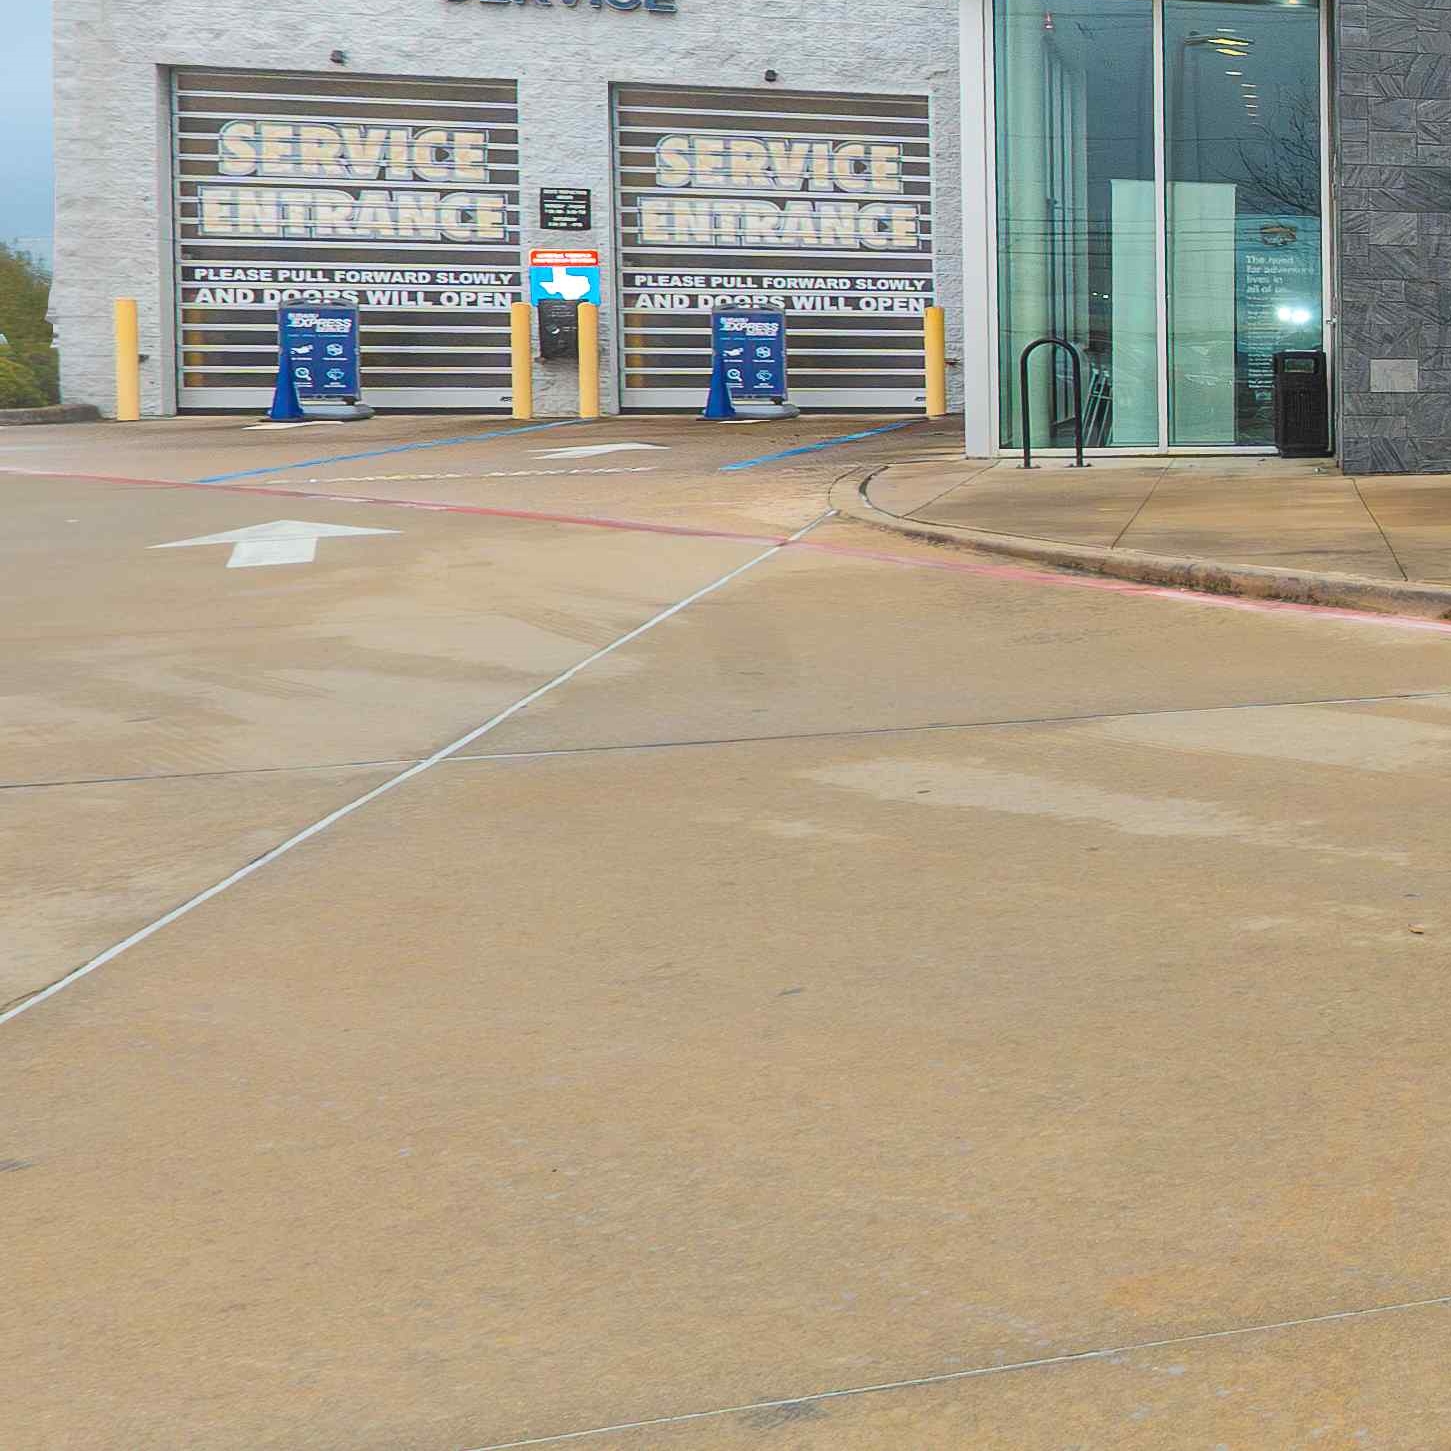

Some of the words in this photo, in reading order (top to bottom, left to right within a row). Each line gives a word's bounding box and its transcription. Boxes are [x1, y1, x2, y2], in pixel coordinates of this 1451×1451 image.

[219, 120, 489, 182] SERVICE
[656, 134, 903, 194] SERVICE
[198, 185, 509, 242] ENTRANCE
[638, 196, 921, 250] ENTRANCE
[194, 267, 273, 283] PLEASE
[277, 268, 329, 283] PULL
[334, 269, 431, 285] FORWARD
[435, 271, 513, 286] SLOWLY
[635, 275, 705, 288] PLEASE
[711, 276, 758, 289] PULL
[763, 277, 850, 290] FORWARD
[855, 278, 926, 292] SLOWLY
[196, 288, 255, 305] AND
[365, 290, 433, 307] WILL
[439, 291, 513, 308] OPEN
[635, 294, 691, 309] AND
[792, 296, 853, 311] WILL
[858, 297, 925, 312] OPEN
